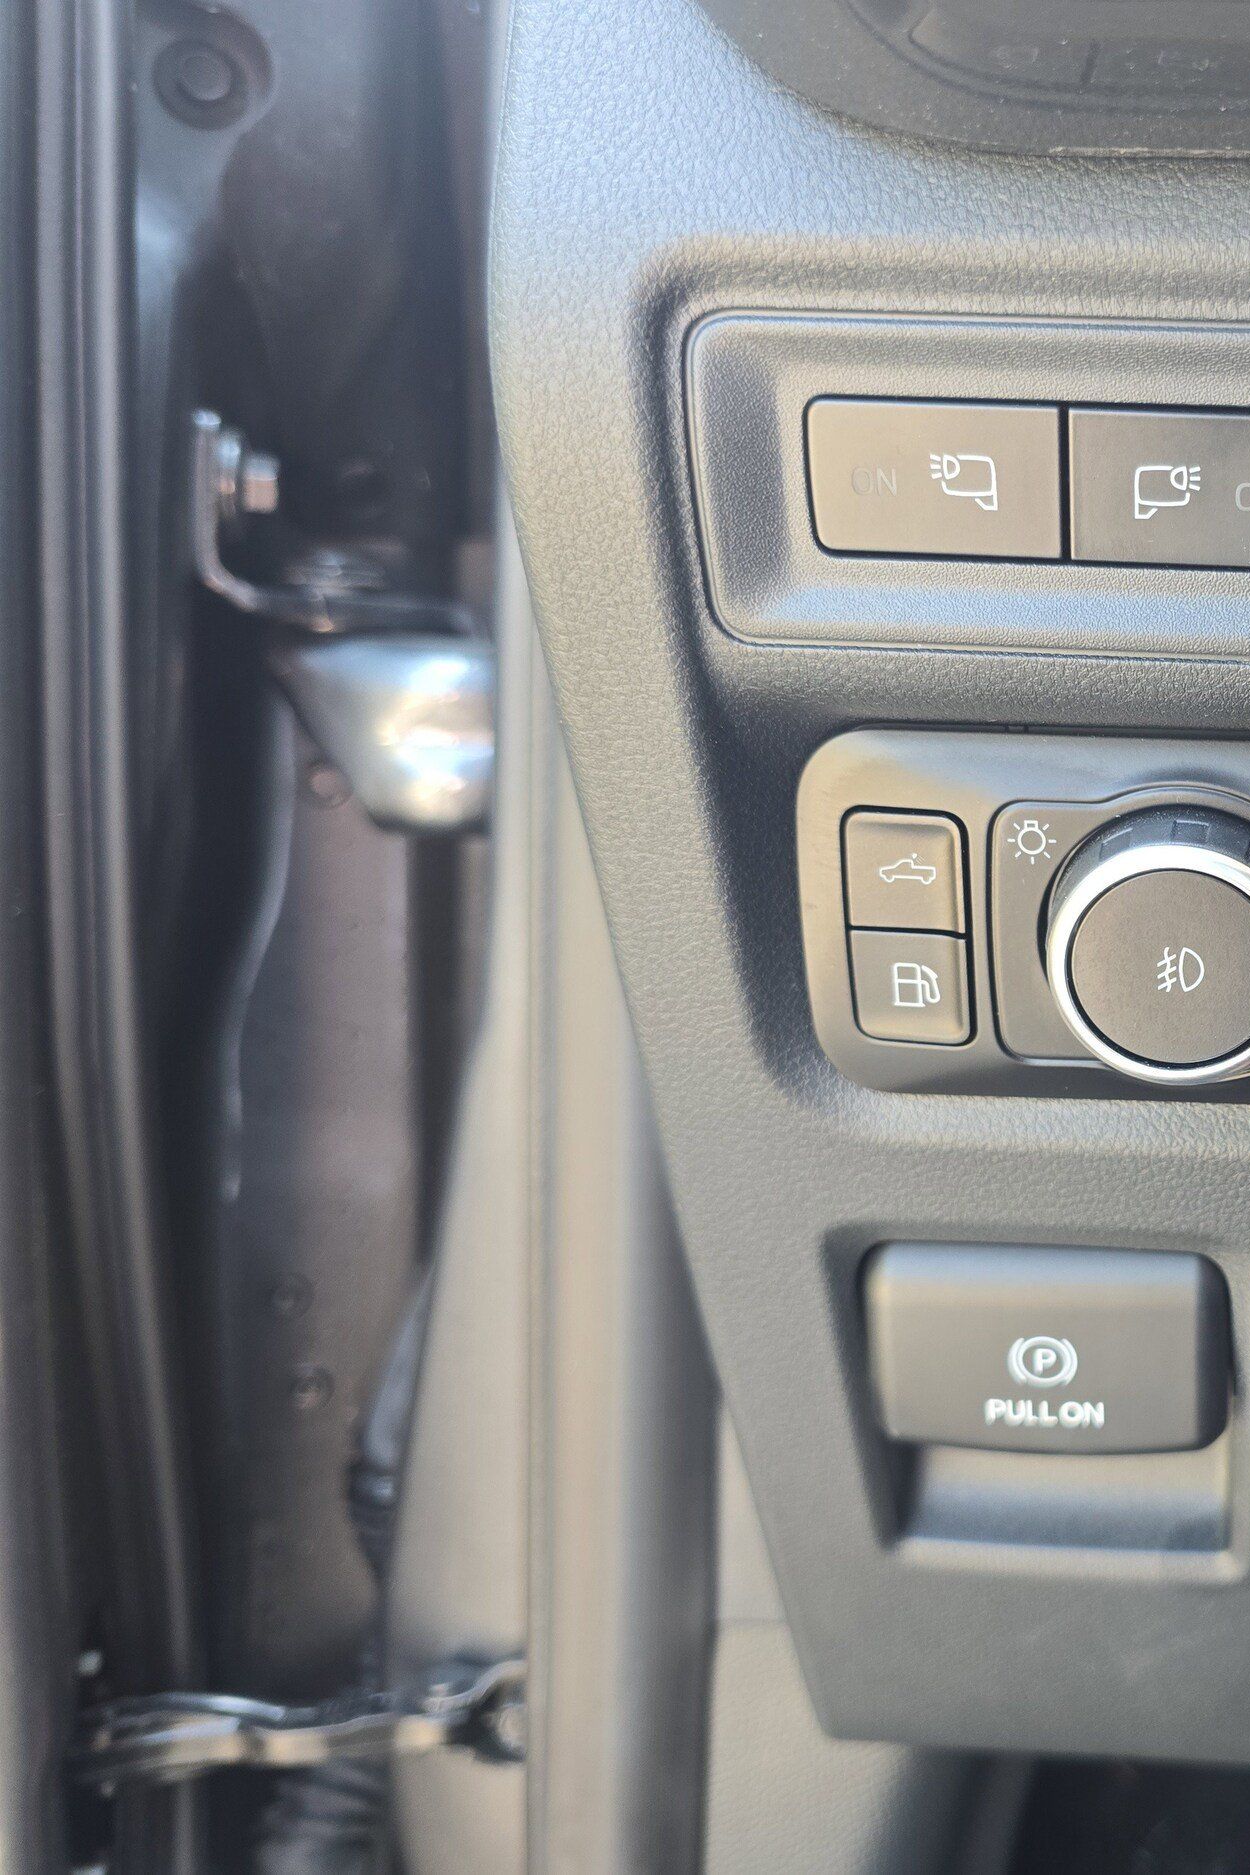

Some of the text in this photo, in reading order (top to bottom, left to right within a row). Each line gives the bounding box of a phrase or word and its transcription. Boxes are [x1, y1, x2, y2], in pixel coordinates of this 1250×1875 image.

[851, 467, 897, 497] ON
[1033, 1348, 1057, 1376] P
[985, 1398, 1105, 1429] PULL ON
